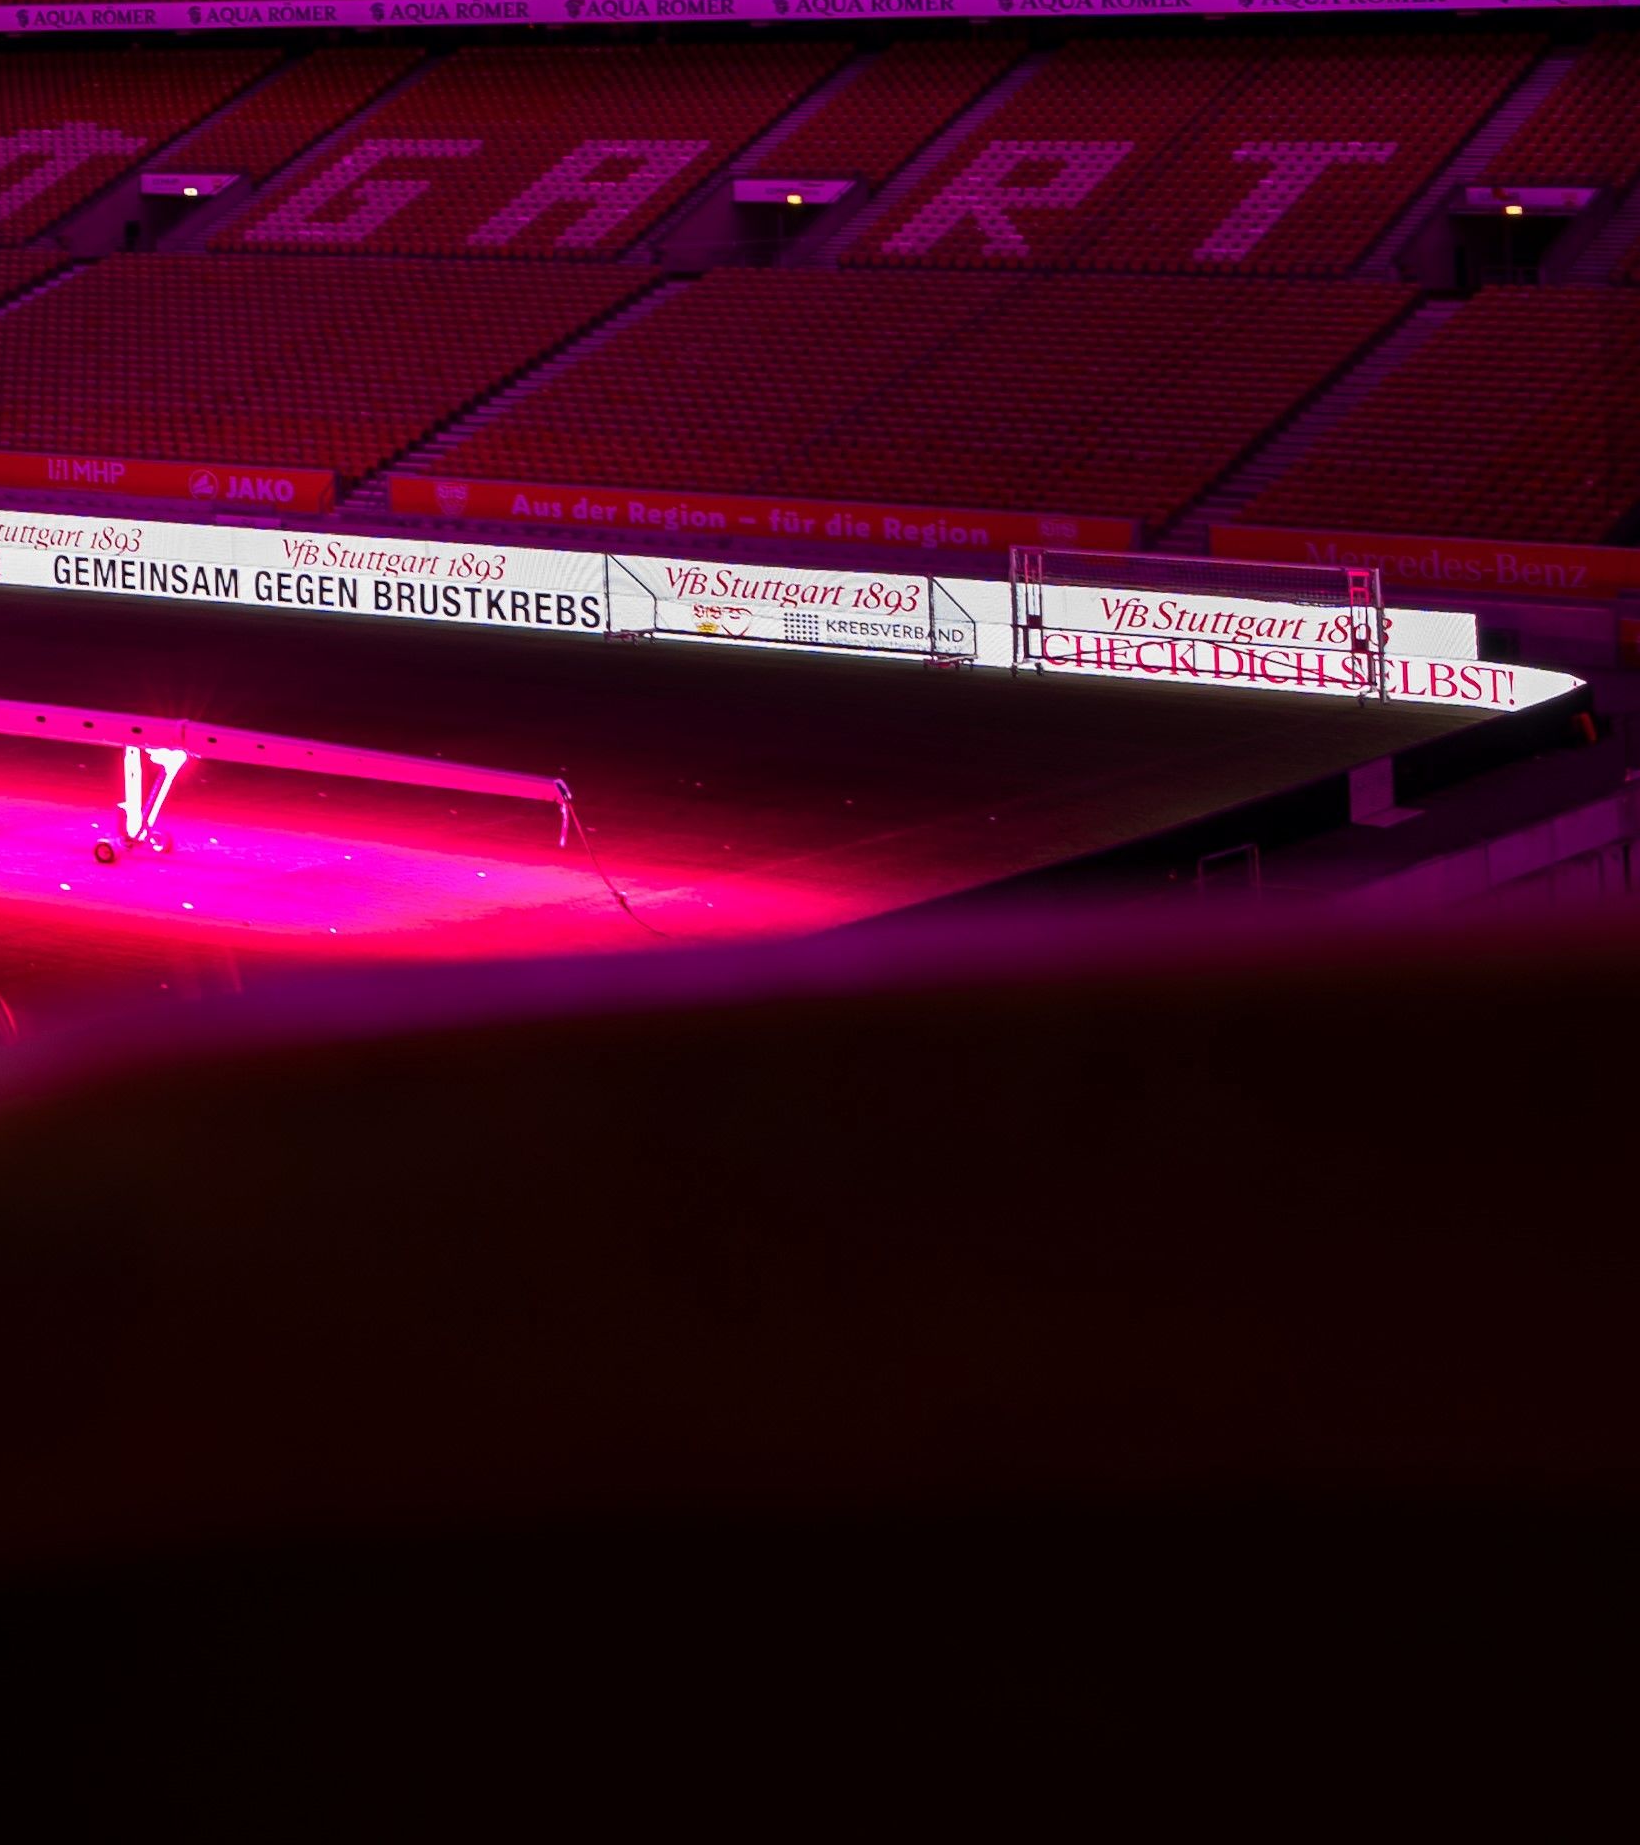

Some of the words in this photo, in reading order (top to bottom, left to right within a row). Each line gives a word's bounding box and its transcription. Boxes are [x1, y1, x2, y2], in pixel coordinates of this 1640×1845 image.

[32, 10, 87, 27] AQUA
[91, 7, 156, 25] RÖMER
[206, 5, 264, 23] AQUA
[267, 2, 337, 22] RÖMER
[390, 3, 453, 21] AQUA
[456, 0, 529, 18] RÖMER
[585, 0, 650, 18] AQUA
[73, 462, 125, 484] MHP
[225, 478, 293, 503] JAKO
[511, 494, 563, 518] Aus
[571, 497, 617, 522] der
[628, 500, 725, 530] Region
[769, 511, 815, 536] für
[825, 513, 872, 538] die
[881, 518, 989, 548] Region
[90, 527, 143, 557] 1893
[282, 538, 322, 569] VfB
[324, 541, 440, 577] Stuttgart
[447, 552, 506, 584] 1893
[54, 556, 239, 600] GEMEINSAM
[255, 572, 358, 610] GEGEN
[665, 566, 708, 600] VfB
[710, 569, 845, 608] Stuttgart
[852, 581, 921, 616] 1893
[825, 619, 964, 643] KREBSVERBAND
[1100, 597, 1149, 631] VfB
[1152, 600, 1307, 644] Stuttgart
[1043, 634, 1200, 677] CHECK
[1212, 643, 1328, 689] DICH
[1342, 655, 1515, 706] SELBST!
